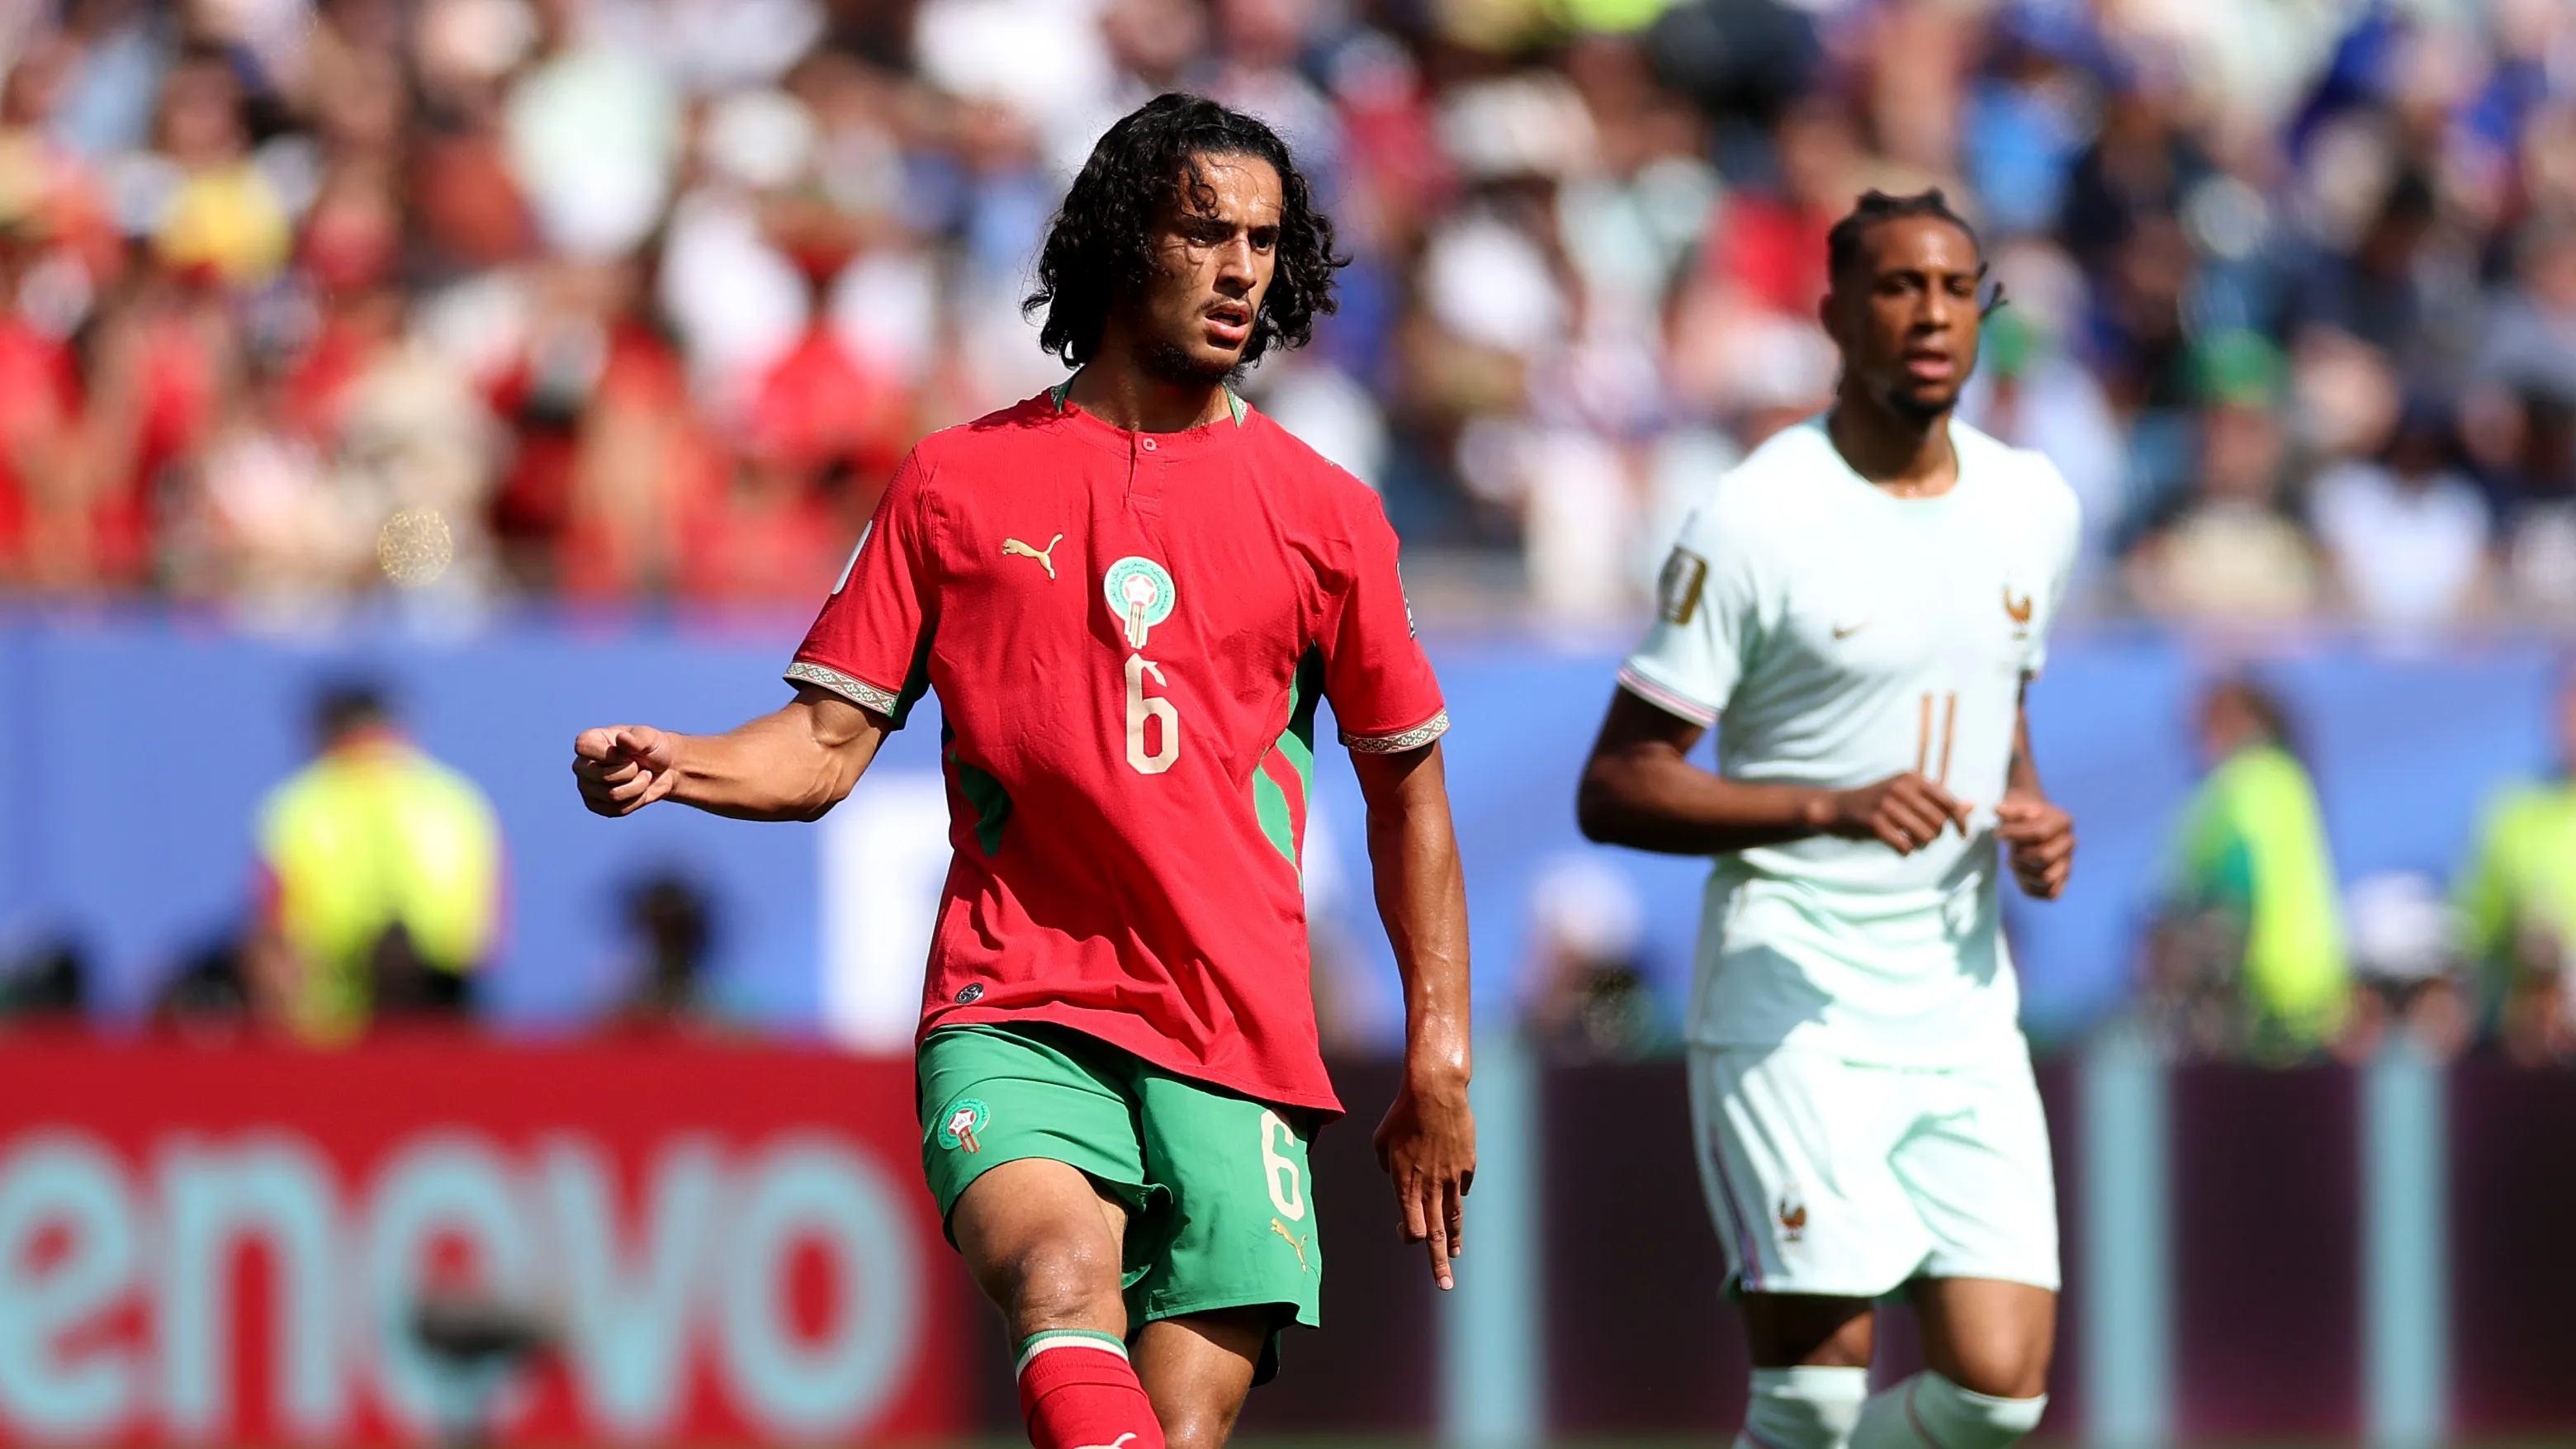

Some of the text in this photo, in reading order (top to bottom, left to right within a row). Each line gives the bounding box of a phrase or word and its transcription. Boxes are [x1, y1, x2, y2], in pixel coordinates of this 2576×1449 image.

[1125, 652, 1179, 774] 6
[1915, 690, 1958, 784] 11
[1261, 1109, 1305, 1221] 6
[0, 1131, 921, 1437] enovo
